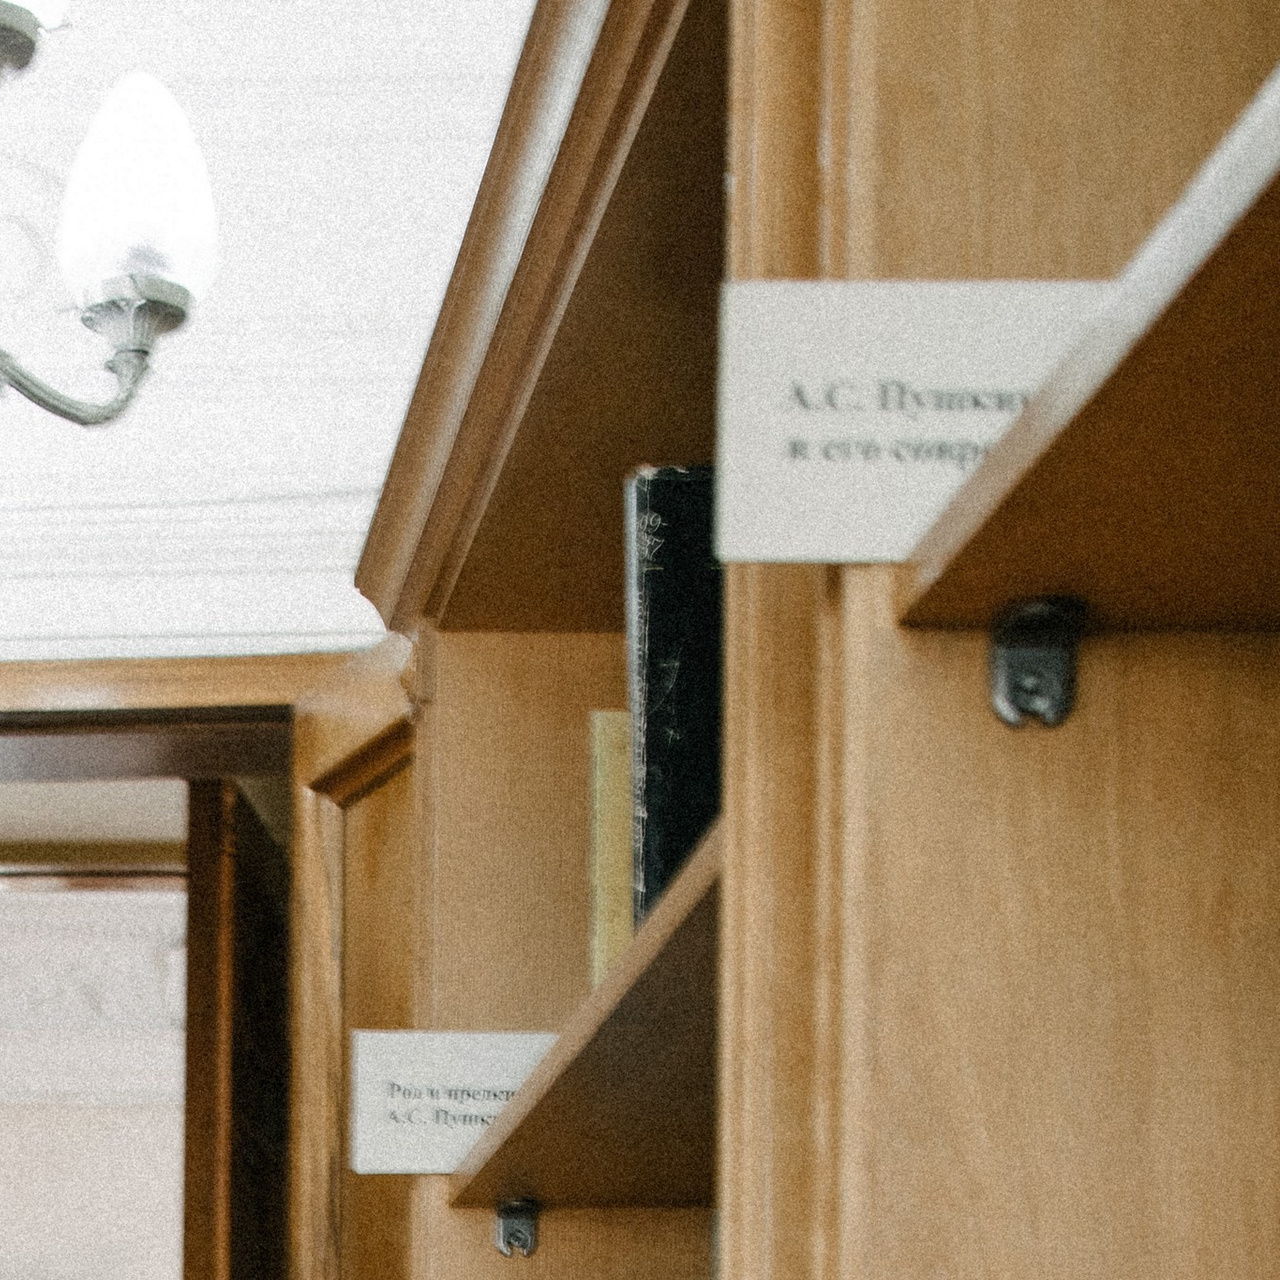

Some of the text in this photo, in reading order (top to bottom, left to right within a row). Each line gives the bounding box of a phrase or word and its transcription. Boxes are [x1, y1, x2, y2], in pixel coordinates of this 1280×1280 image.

[789, 379, 862, 412] А.С.
[788, 439, 808, 461] и
[822, 438, 881, 462] его
[388, 1081, 421, 1100] Род
[428, 1088, 441, 1100] и
[389, 1108, 498, 1129] А.С. Пушк
